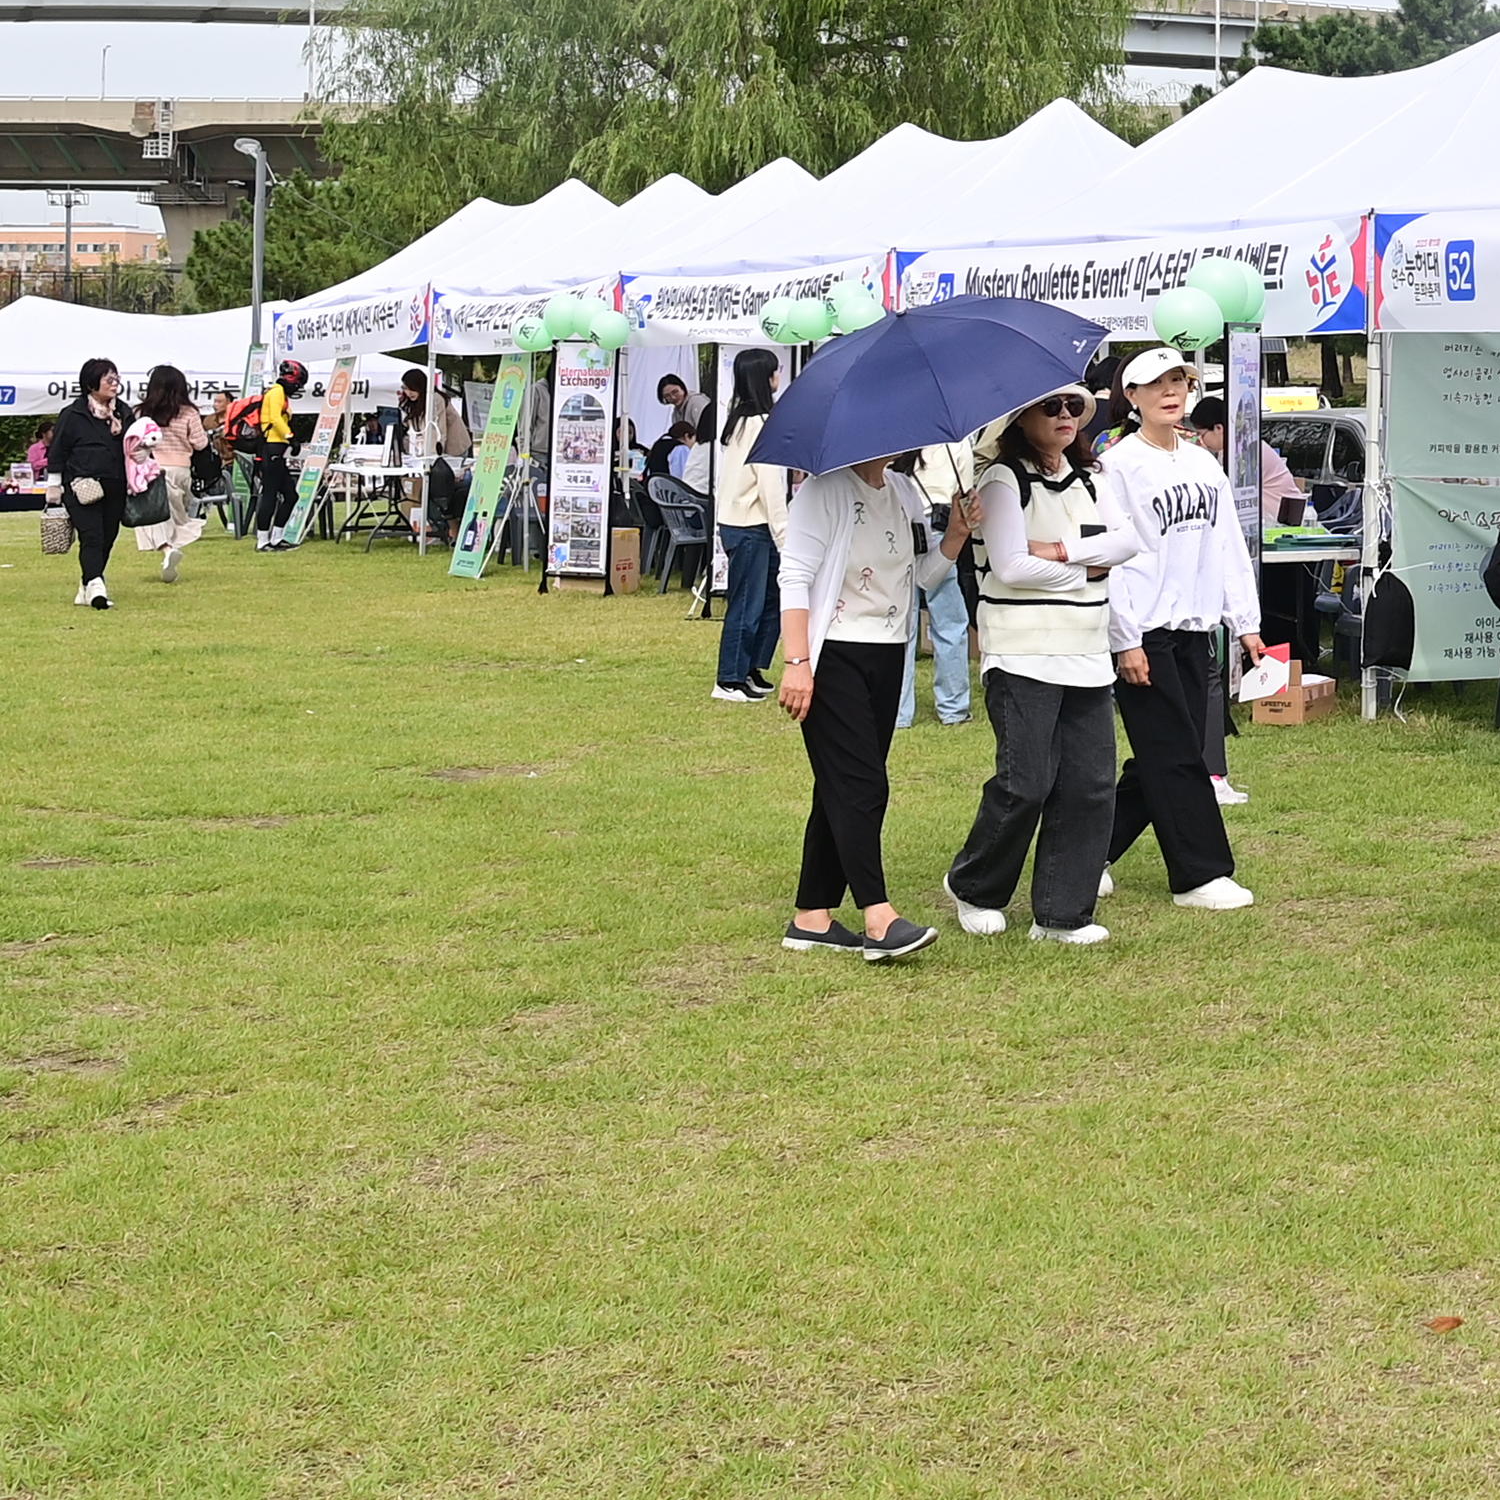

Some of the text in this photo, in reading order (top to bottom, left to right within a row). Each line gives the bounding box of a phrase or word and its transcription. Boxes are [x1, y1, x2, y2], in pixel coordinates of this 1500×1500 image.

[965, 266, 1019, 298] Mystery
[1021, 263, 1080, 300] Roulette
[1082, 256, 1134, 299] Event!
[1392, 251, 1440, 290] 연수 능허대
[1449, 251, 1472, 291] 52
[1415, 282, 1441, 302] 문화축제
[741, 285, 771, 316] Game
[559, 366, 611, 376] International
[560, 375, 607, 389] Exchange
[0, 388, 14, 403] 7
[48, 381, 131, 401] 어르이
[1443, 391, 1492, 405] 지속가능한
[1464, 444, 1488, 454] 활용한
[1464, 631, 1494, 643] 재사용
[1443, 645, 1496, 659] 재사용 가능
